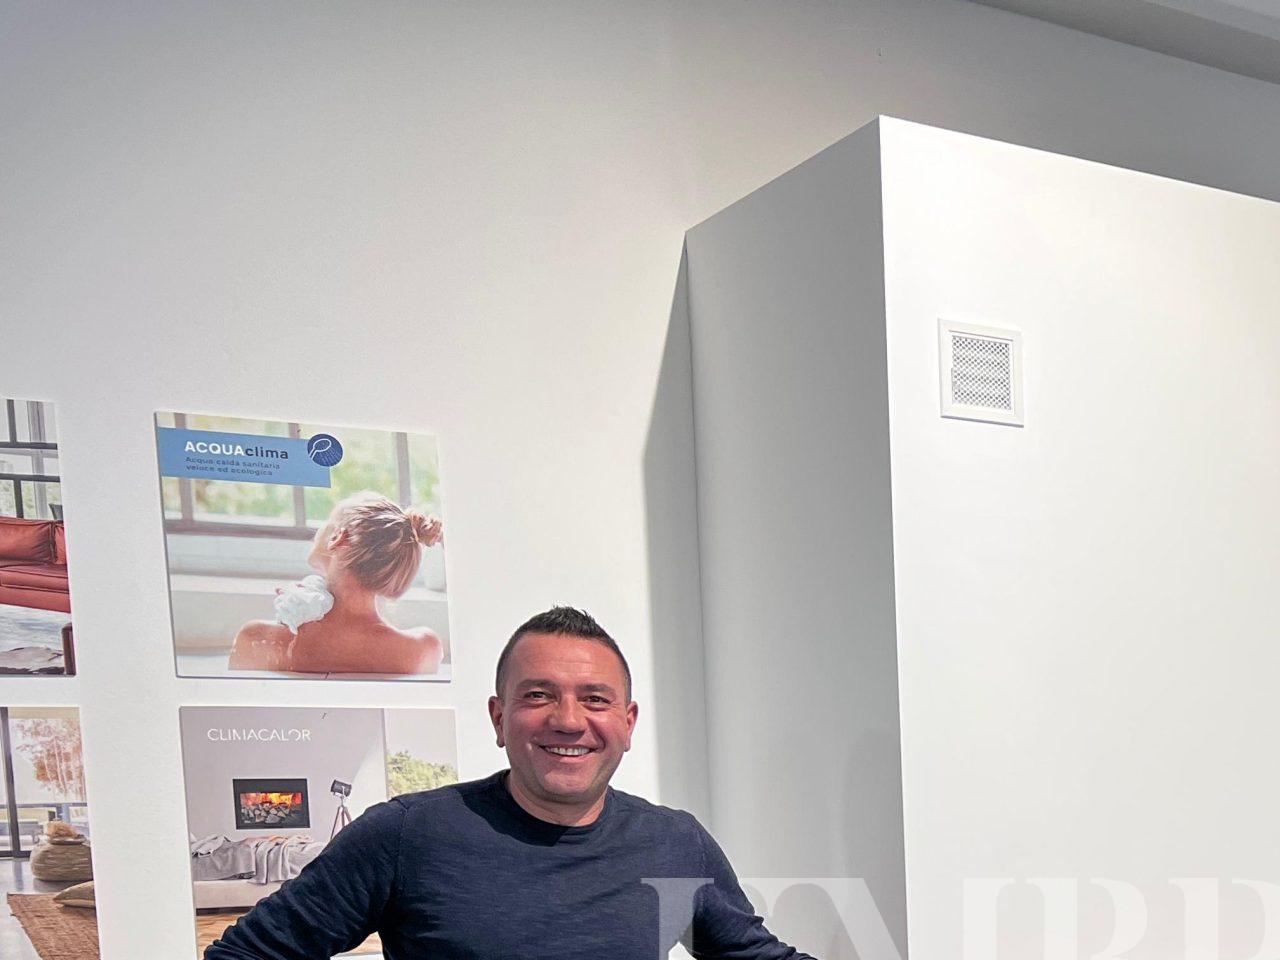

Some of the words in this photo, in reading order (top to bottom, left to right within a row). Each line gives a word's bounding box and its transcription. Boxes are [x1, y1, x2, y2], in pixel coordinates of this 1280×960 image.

[184, 440, 289, 460] ACQUAclima
[185, 456, 214, 465] Acqua
[216, 458, 240, 467] calda
[242, 460, 281, 470] sanitaria
[186, 464, 216, 472] veloce
